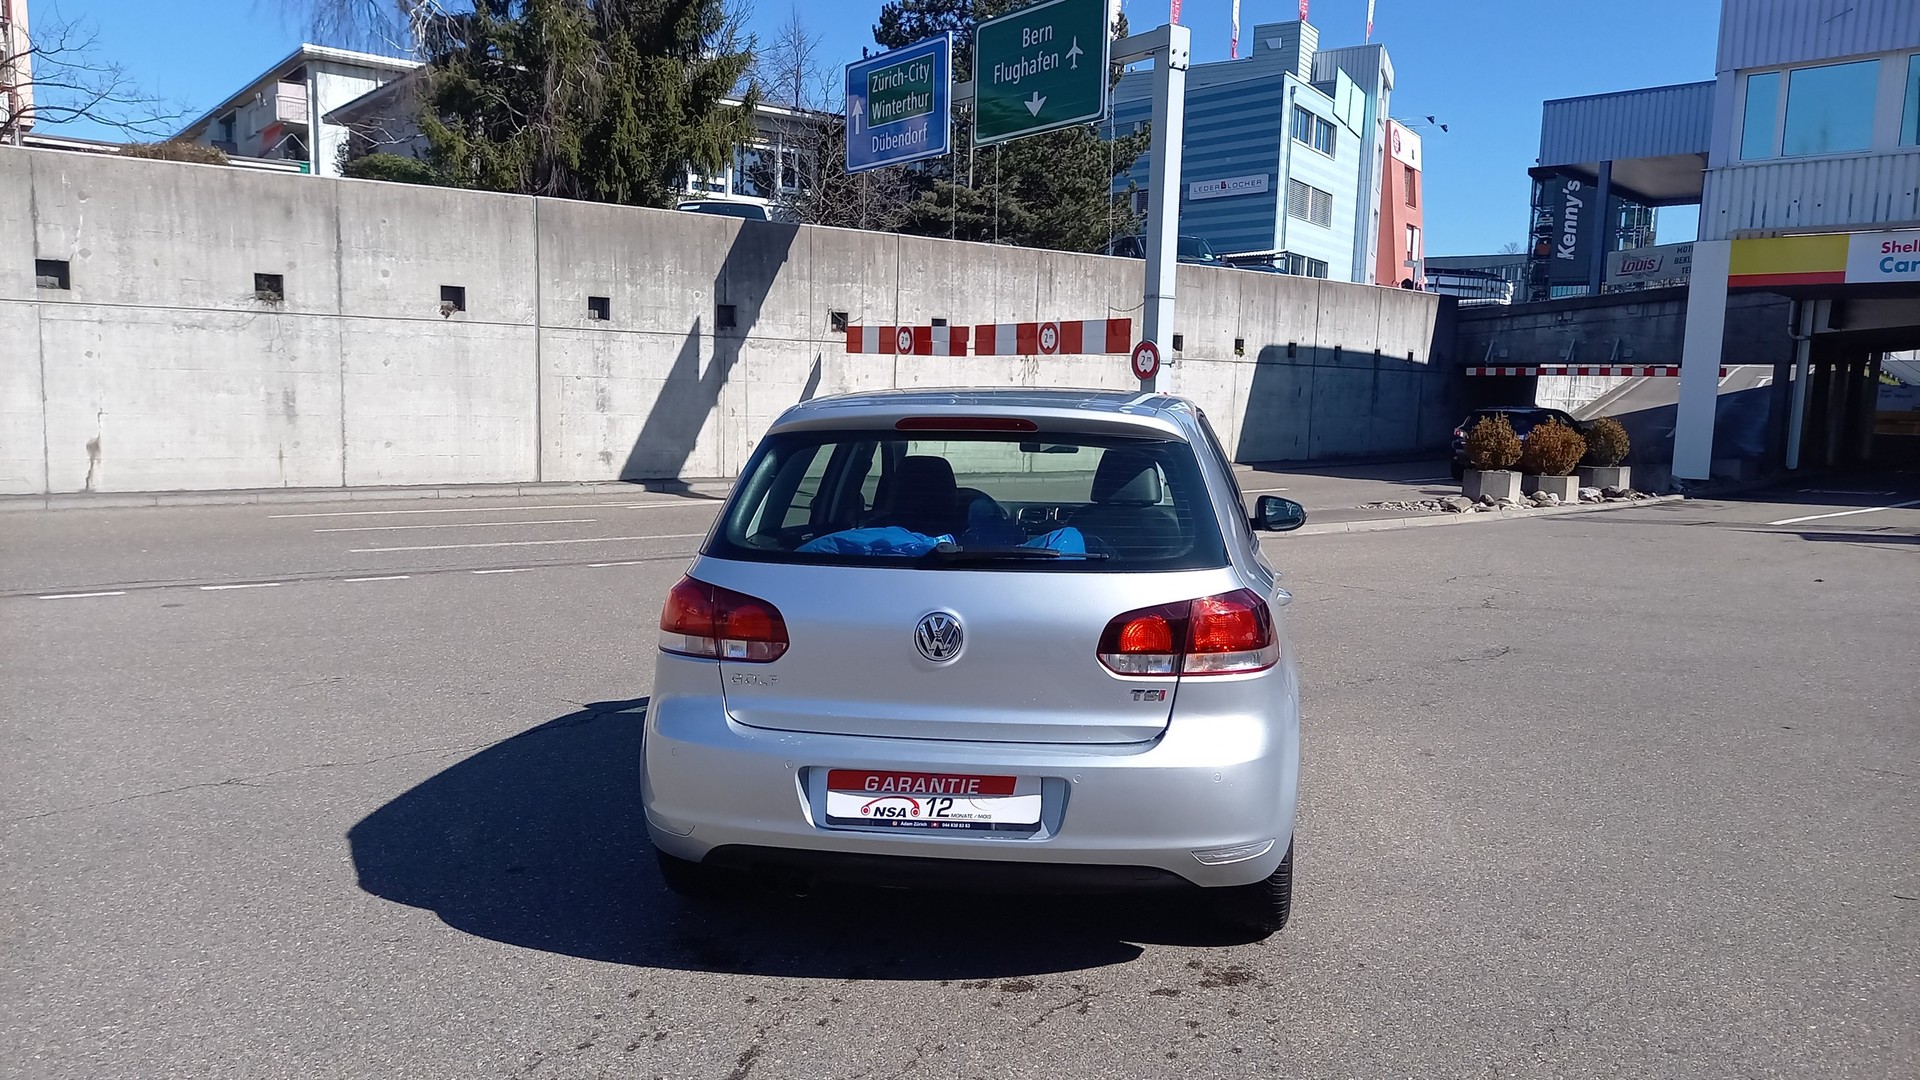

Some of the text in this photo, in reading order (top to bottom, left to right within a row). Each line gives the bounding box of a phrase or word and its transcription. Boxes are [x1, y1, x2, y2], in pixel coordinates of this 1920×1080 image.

[1021, 24, 1054, 48] Bern
[871, 61, 931, 93] Zürich-City
[993, 50, 1060, 85] Flughafen
[871, 91, 930, 120] Winterthur
[871, 123, 928, 153] Dübendorf
[1556, 179, 1583, 260] Kenny's
[1620, 257, 1656, 273] Louis
[1879, 256, 1920, 273] Car
[731, 672, 779, 686] GOLF
[1130, 689, 1167, 702] TSI
[863, 775, 981, 795] GARANTIE
[873, 805, 907, 819] NSA
[925, 796, 954, 818] 12
